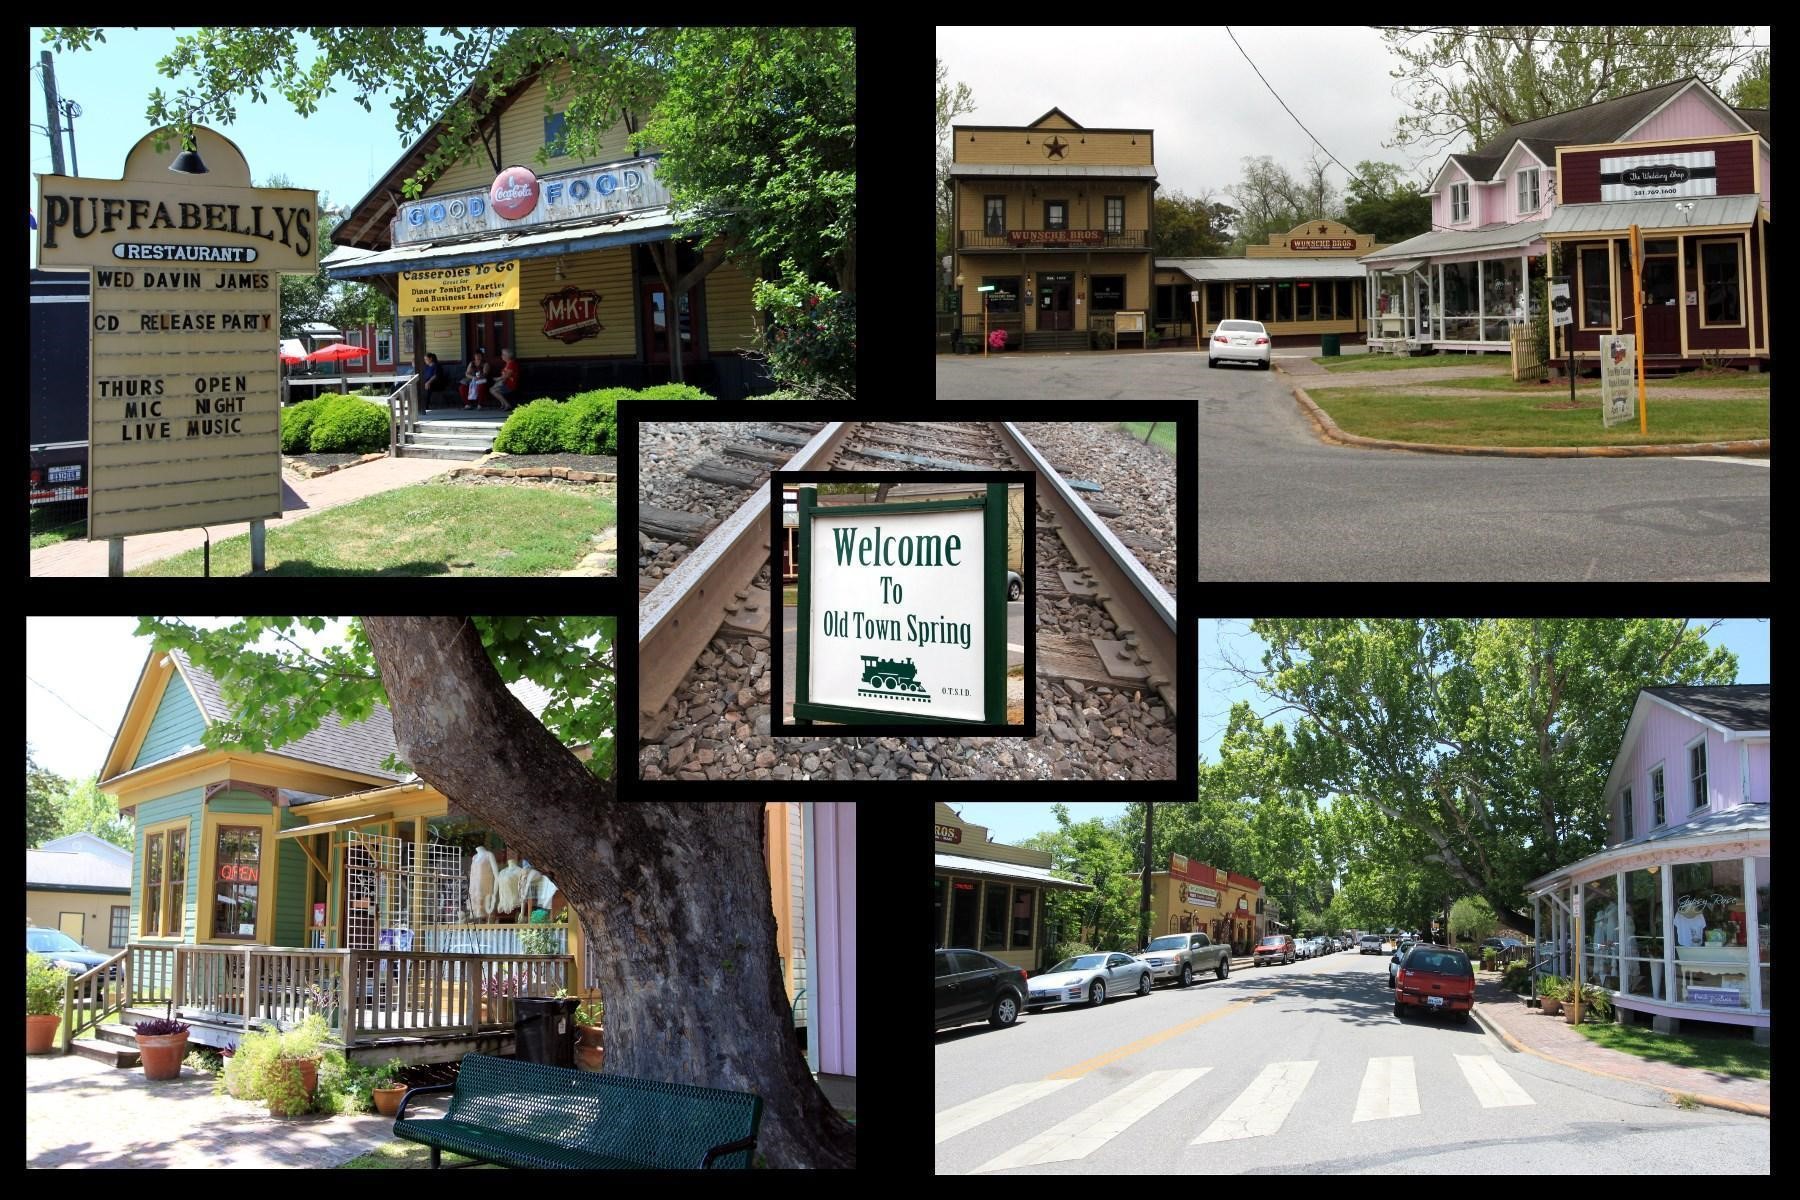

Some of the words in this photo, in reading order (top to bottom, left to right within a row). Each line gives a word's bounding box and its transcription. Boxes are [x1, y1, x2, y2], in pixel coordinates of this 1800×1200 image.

[545, 169, 642, 205] FOOD
[408, 197, 485, 227] GOOD
[43, 195, 311, 257] PUFFABELLYS
[127, 244, 244, 262] RESTAURANT
[97, 271, 134, 288] WED
[144, 272, 201, 288] DAVIN
[215, 272, 269, 289] JAMES
[403, 267, 471, 280] Casseroles
[475, 263, 491, 275] To
[495, 261, 514, 272] Go
[411, 287, 437, 295] Dinner
[475, 282, 504, 291] Parties
[415, 295, 429, 303] and
[431, 293, 466, 302] Business
[467, 291, 502, 300] Lunches
[95, 314, 120, 331] CD
[140, 314, 216, 330] RELEASE
[221, 314, 271, 330] PARTY
[99, 379, 165, 397] THURS
[194, 376, 247, 395] OPEN
[124, 401, 163, 419] MIC
[122, 421, 171, 441] LIVE
[186, 418, 241, 437] MUSIC
[833, 527, 962, 567] Welcome
[880, 576, 903, 605] To
[823, 610, 848, 638] Old
[853, 612, 902, 641] Town
[907, 614, 971, 650] Spring
[221, 864, 258, 881] OPEN
